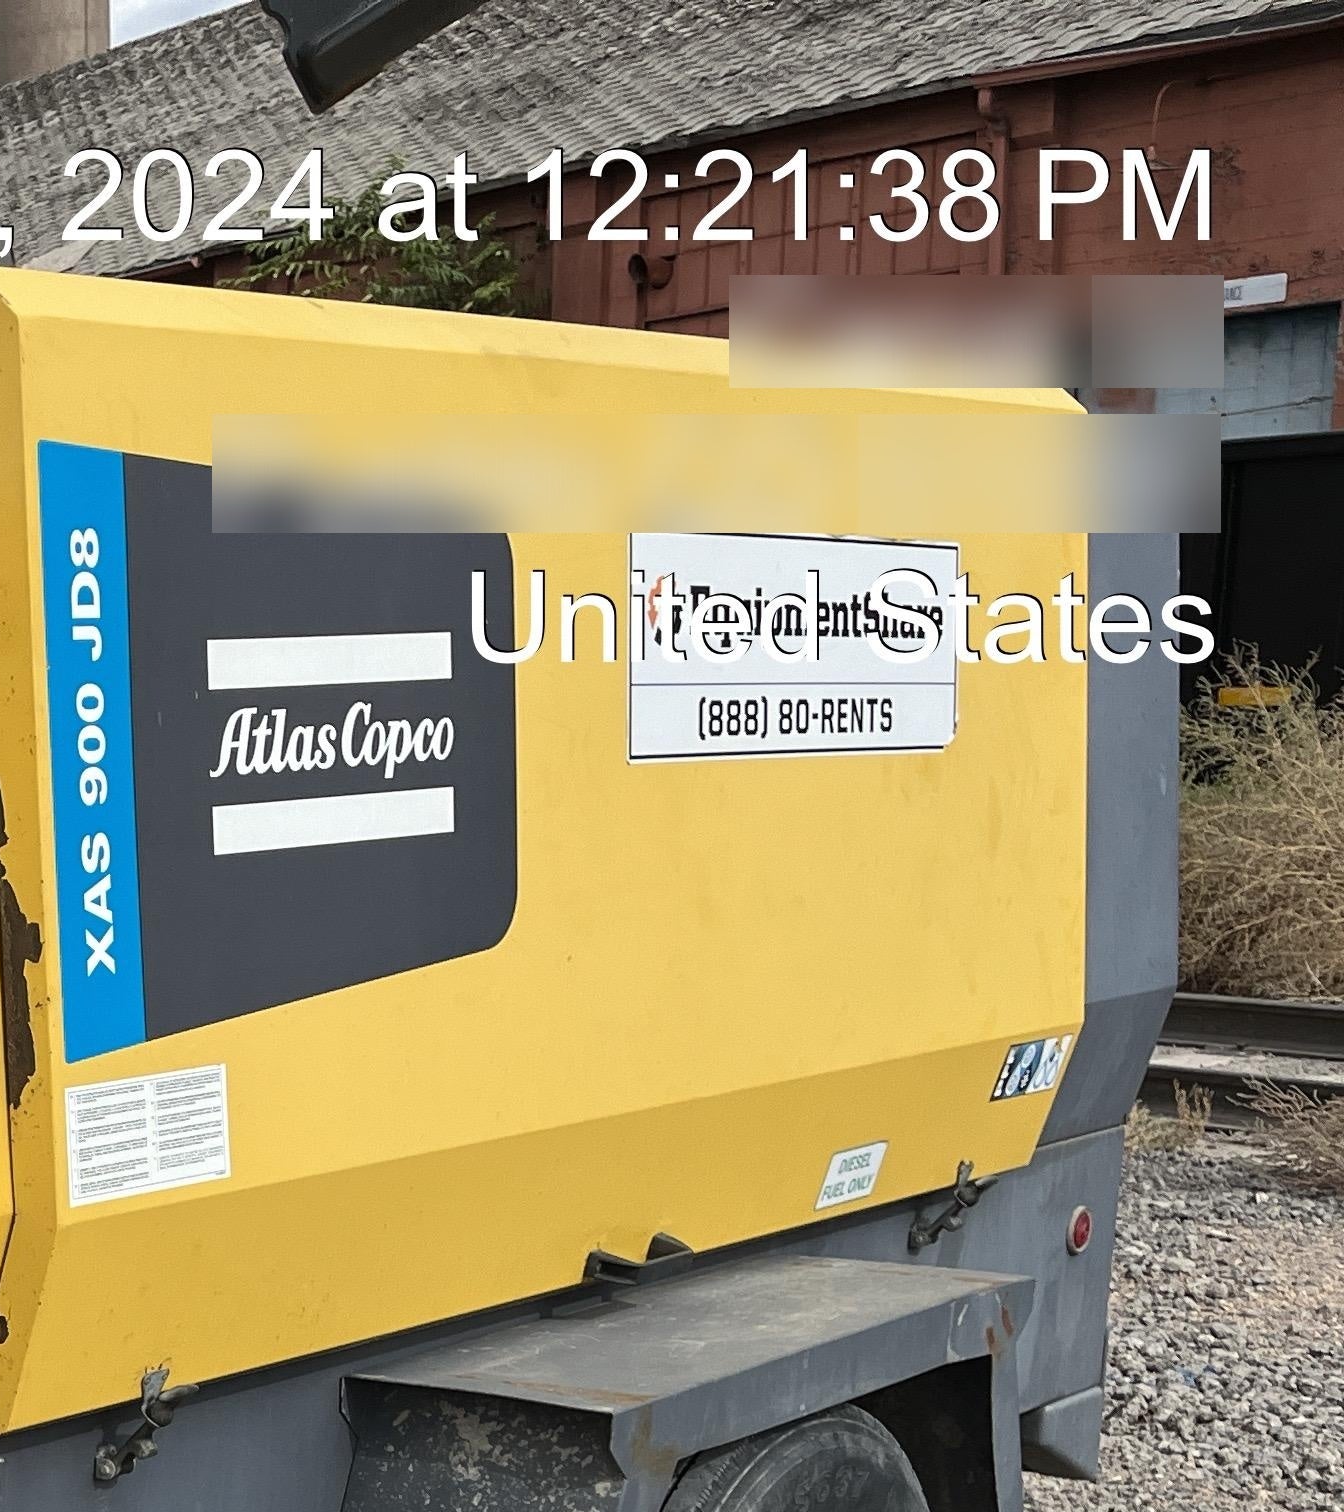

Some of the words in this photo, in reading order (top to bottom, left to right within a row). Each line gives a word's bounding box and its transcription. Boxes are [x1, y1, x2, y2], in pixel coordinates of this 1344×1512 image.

[70, 527, 103, 662] JD8
[75, 683, 108, 806] 900
[209, 706, 337, 779] Atlas
[340, 701, 455, 779] Copco
[697, 697, 769, 741] (888)
[778, 697, 894, 736] 80-RENTS
[81, 831, 116, 977] XAS
